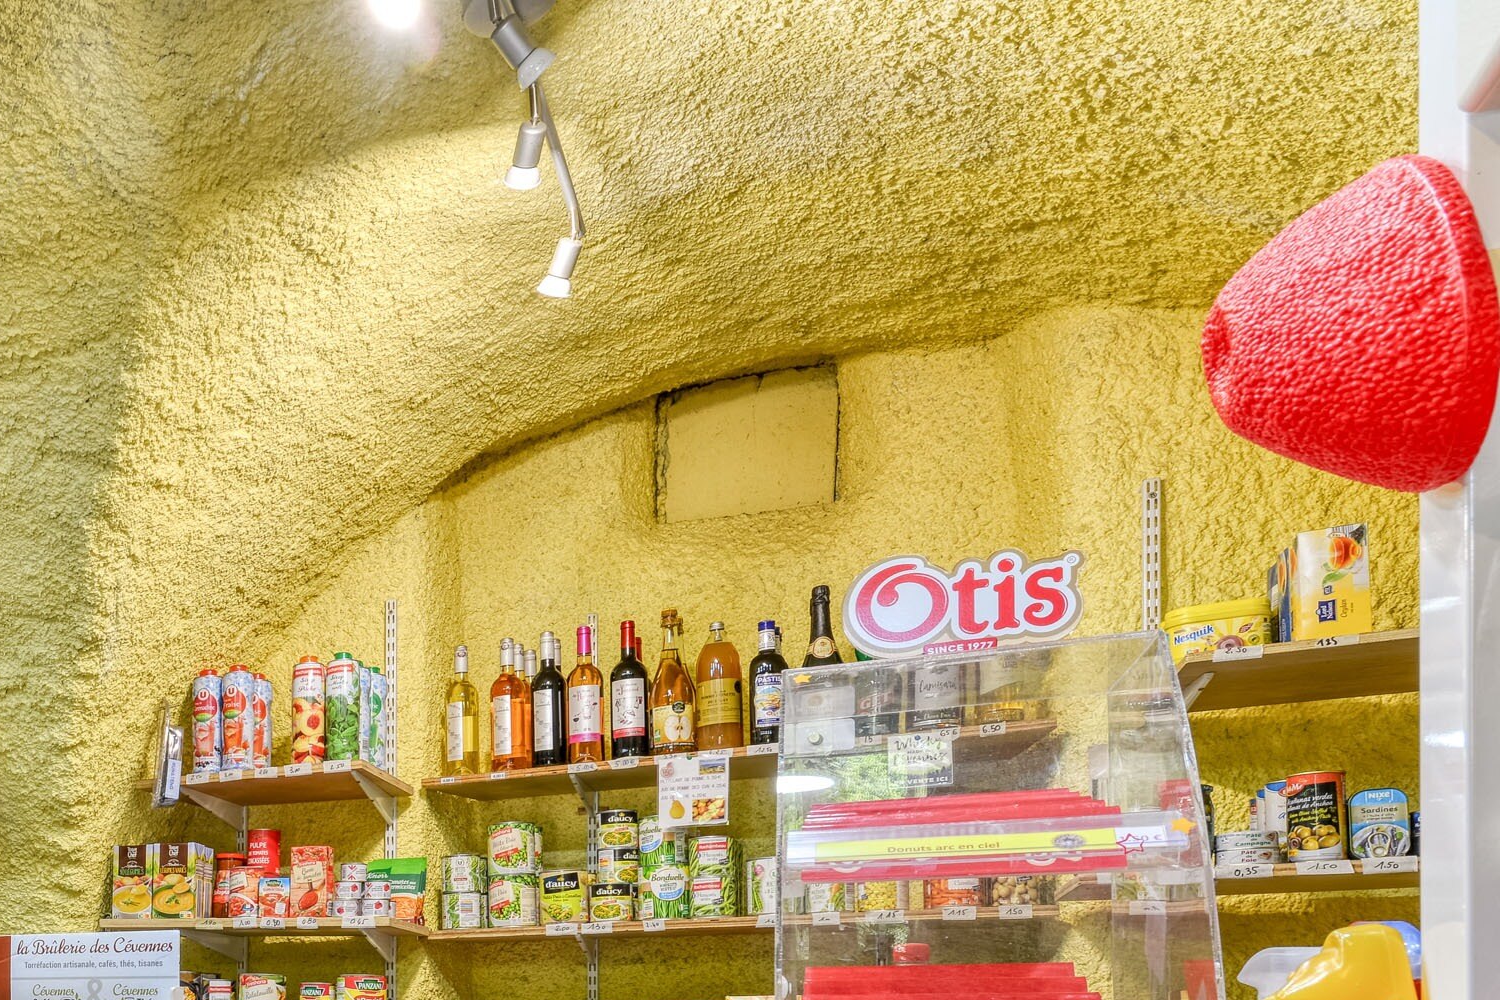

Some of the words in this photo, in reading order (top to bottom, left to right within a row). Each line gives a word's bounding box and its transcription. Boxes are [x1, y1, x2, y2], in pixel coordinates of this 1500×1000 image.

[856, 558, 1068, 642] Otis
[1173, 625, 1215, 645] Nesquik
[927, 643, 964, 655] SINCE
[967, 641, 993, 652] 1977
[228, 686, 235, 695] U
[982, 724, 1001, 734] 6.50
[1368, 791, 1391, 799] NIXE
[1360, 805, 1399, 814] Sardines
[607, 815, 634, 824] d'aucy
[249, 841, 267, 850] PULPE
[887, 845, 934, 854] Donuts
[936, 844, 955, 852] arc
[978, 841, 1001, 850] ciel
[366, 871, 389, 880] Knorr
[1234, 866, 1260, 877] 0,35
[545, 876, 578, 889] d'aucy
[651, 873, 685, 883] Bonduelle
[596, 887, 623, 896] d'aucy
[17, 940, 28, 955] la
[32, 938, 86, 955] Brûlerie
[90, 938, 110, 954] des
[113, 936, 173, 953] Cévennes
[25, 961, 62, 969] Torréfaction
[63, 960, 97, 969] artisanale,
[99, 960, 118, 969] cafés,
[120, 960, 137, 969] thés,
[138, 959, 163, 968] tisanes
[32, 983, 75, 997] Cévennes
[113, 983, 158, 997] Cévennes
[358, 982, 384, 990] PANZANI
